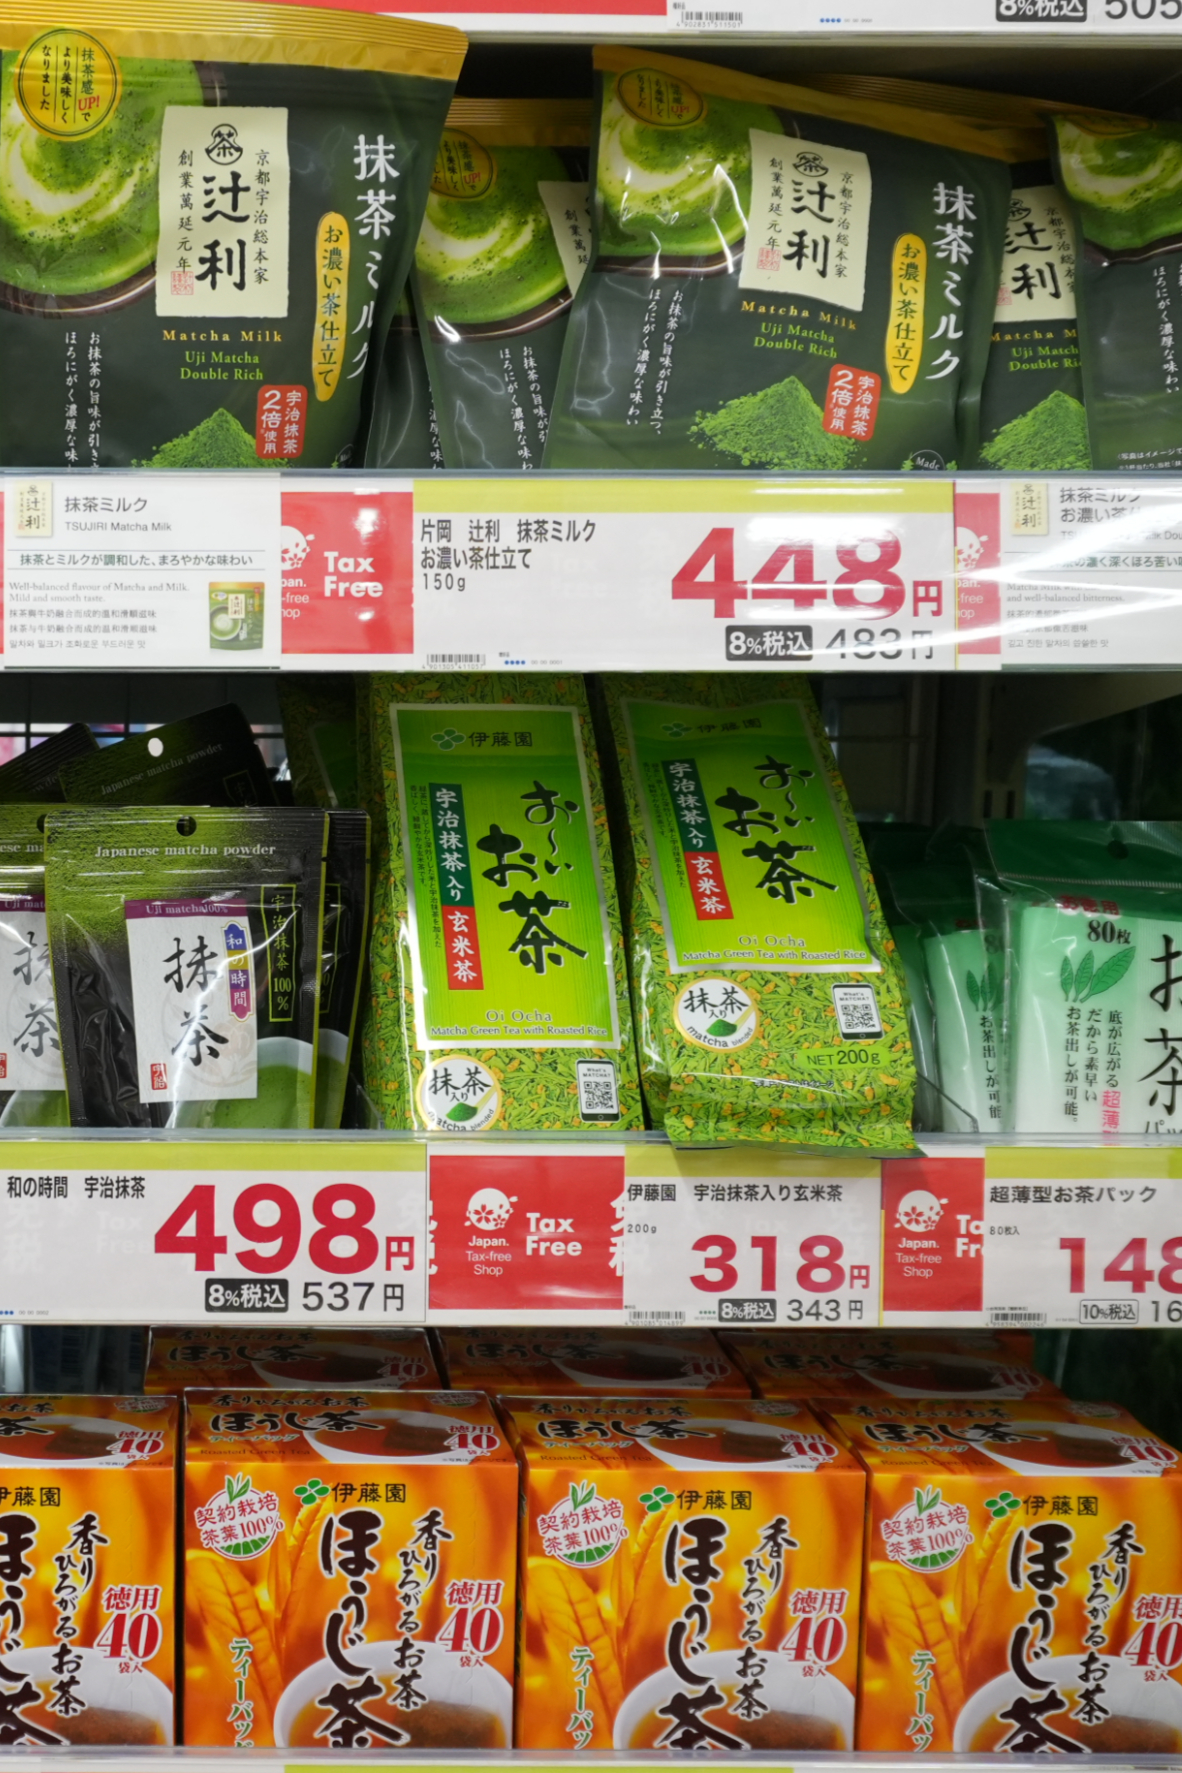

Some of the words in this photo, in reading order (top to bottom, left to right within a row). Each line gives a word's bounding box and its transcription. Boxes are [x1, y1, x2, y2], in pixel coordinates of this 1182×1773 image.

[253, 149, 271, 285] 京都宇治総本家
[834, 171, 854, 278] 京都宇治総本家
[195, 171, 251, 292] 辻利
[783, 179, 836, 279] 辻利
[925, 182, 977, 380] 抹茶ミルク
[318, 225, 344, 388] お濃い茶仕立て
[741, 301, 811, 318] Matcha
[819, 312, 858, 330] Milk
[891, 243, 921, 382] お濃い茶仕立て
[163, 330, 230, 341] Matcha
[240, 330, 283, 342] Milk
[760, 322, 783, 336] Uji
[788, 326, 835, 343] Matcha
[185, 351, 206, 366] Uji
[211, 351, 260, 364] Matcha
[753, 336, 805, 352] Double
[809, 343, 838, 359] Rich
[180, 367, 229, 381] Double
[233, 368, 264, 381] Rich
[1009, 358, 1059, 372] Double
[64, 496, 149, 513] 抹茶ミルク
[64, 521, 108, 533] TSUJIRI
[111, 521, 148, 533] Matcha
[151, 521, 172, 533] Milk
[420, 519, 453, 543] 片岡
[468, 519, 501, 543] 辻利
[517, 519, 597, 543] 抹茶ミルク
[19, 553, 254, 567] 抹茶とミルクが調和した、まろやかな味わい
[323, 551, 376, 573] Tax
[420, 547, 532, 571] お濃い茶仕立て
[422, 573, 467, 593] 150g
[94, 844, 160, 859] Japanese
[164, 843, 218, 856] matcha
[223, 843, 277, 859] powder
[738, 935, 759, 947] Oi
[764, 935, 806, 948] Ocha
[682, 950, 721, 961] Matcha
[723, 949, 754, 959] Green
[757, 949, 775, 959] Tea
[777, 949, 799, 960] with
[801, 950, 841, 960] Roasted
[843, 950, 866, 960] Rice
[163, 935, 229, 1067] 抹茶
[683, 985, 749, 1015] 抹茶
[485, 1009, 505, 1022] Oi
[511, 1009, 553, 1022] Ocha
[430, 1026, 468, 1036] Matcha
[470, 1026, 501, 1036] Green
[503, 1026, 521, 1036] Tea
[523, 1026, 545, 1036] with
[547, 1026, 585, 1036] Roasted
[587, 1027, 608, 1037] Rice
[428, 1066, 492, 1096] 抹茶
[6, 1175, 69, 1199] 和の時間
[84, 1175, 146, 1199] 宇治抹茶
[626, 1183, 677, 1203] 伊藤園
[693, 1183, 844, 1203] 宇治抹茶入り玄米茶
[989, 1185, 1158, 1204] 超薄型お茶パック
[525, 1212, 575, 1234] Tax
[627, 1223, 658, 1236] 200g
[989, 1225, 1020, 1236] 80枚入
[525, 1236, 583, 1258] Free
[899, 1237, 940, 1252] Japan.
[465, 1250, 513, 1263] Tax-free
[895, 1252, 943, 1266] Tax-free
[473, 1264, 504, 1279] Shop
[903, 1266, 934, 1281] Shop
[331, 1480, 407, 1504] 伊藤園
[676, 1489, 753, 1512] 伊藤園
[1023, 1494, 1099, 1517] 伊藤園
[102, 1585, 160, 1612] 徳用
[446, 1580, 505, 1606] 徳用
[790, 1589, 848, 1616] 徳用
[96, 1612, 161, 1661] 40
[437, 1606, 504, 1655] 40
[782, 1615, 848, 1665] 40
